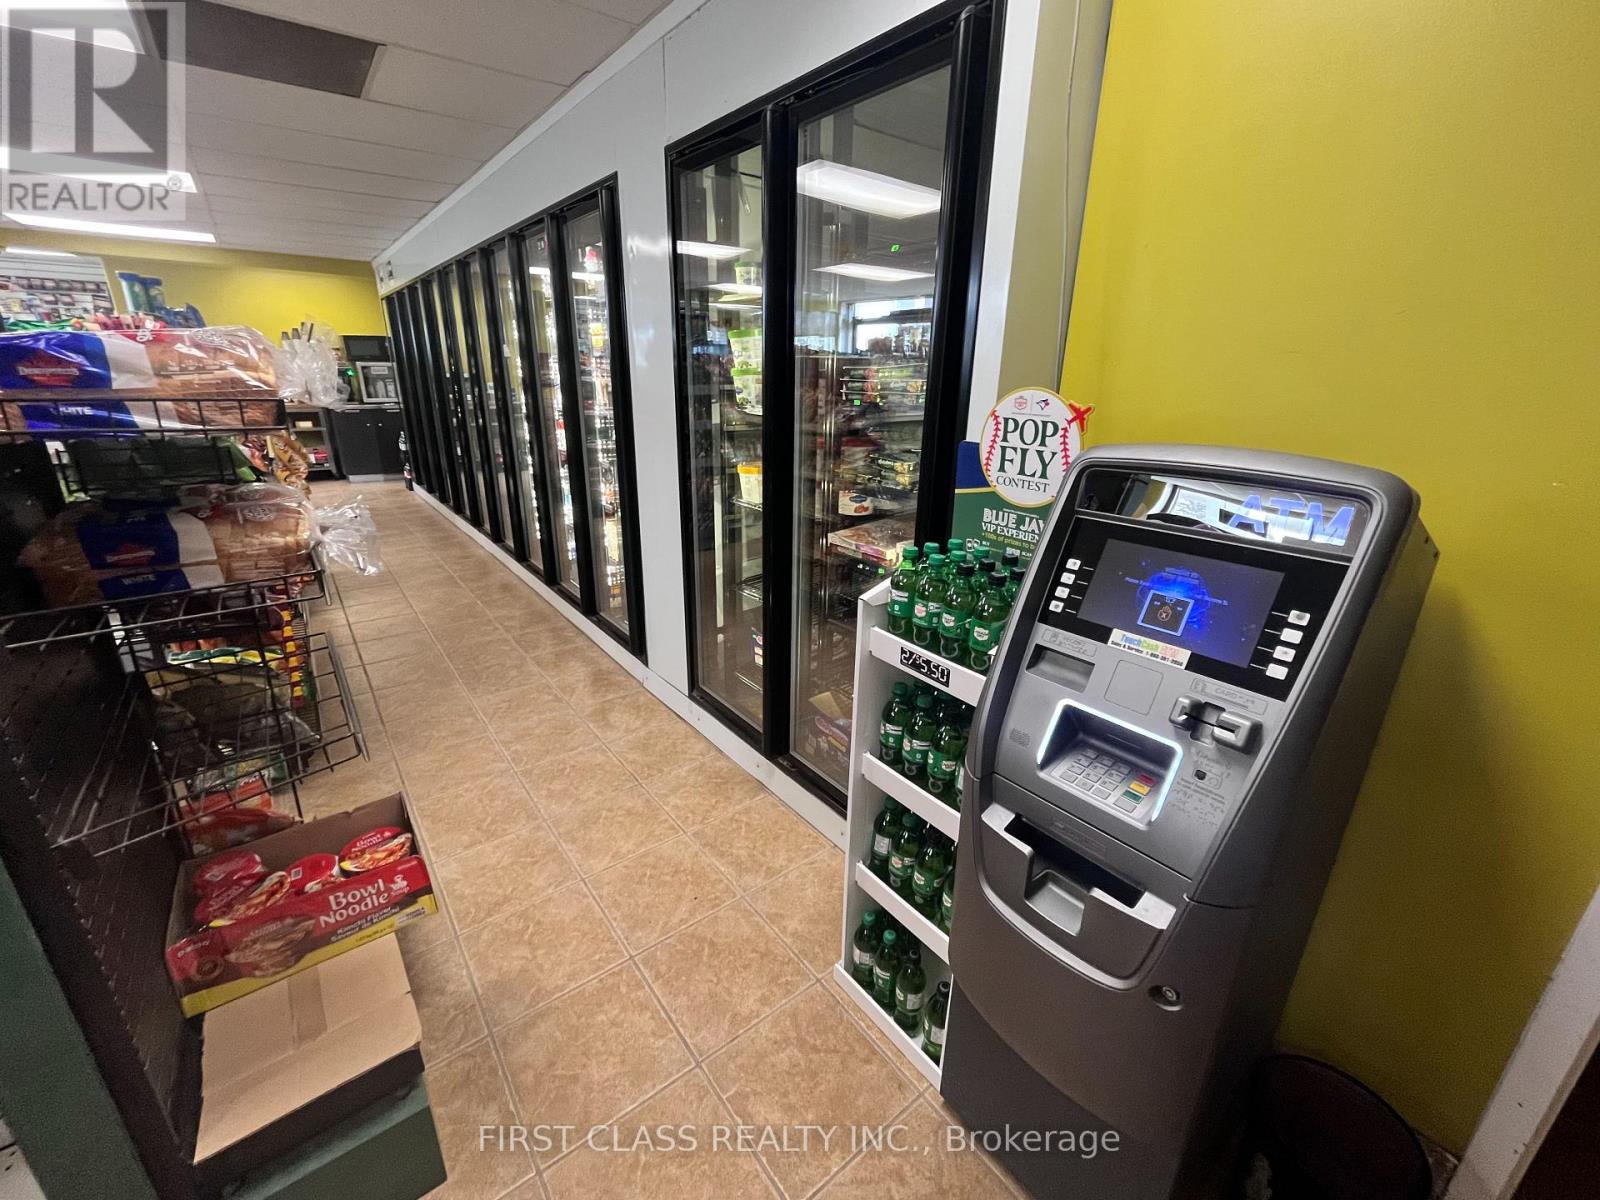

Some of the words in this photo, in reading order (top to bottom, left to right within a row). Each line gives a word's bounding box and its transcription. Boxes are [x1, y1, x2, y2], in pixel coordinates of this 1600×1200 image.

[1001, 417, 1059, 447] POP
[997, 445, 1059, 480] FLY
[996, 475, 1050, 494] CONTEST
[981, 522, 997, 532] VIP
[983, 507, 1018, 529] BLUE
[1226, 494, 1356, 547] ATM
[328, 878, 385, 911] Bowl
[318, 892, 391, 929] Noodle
